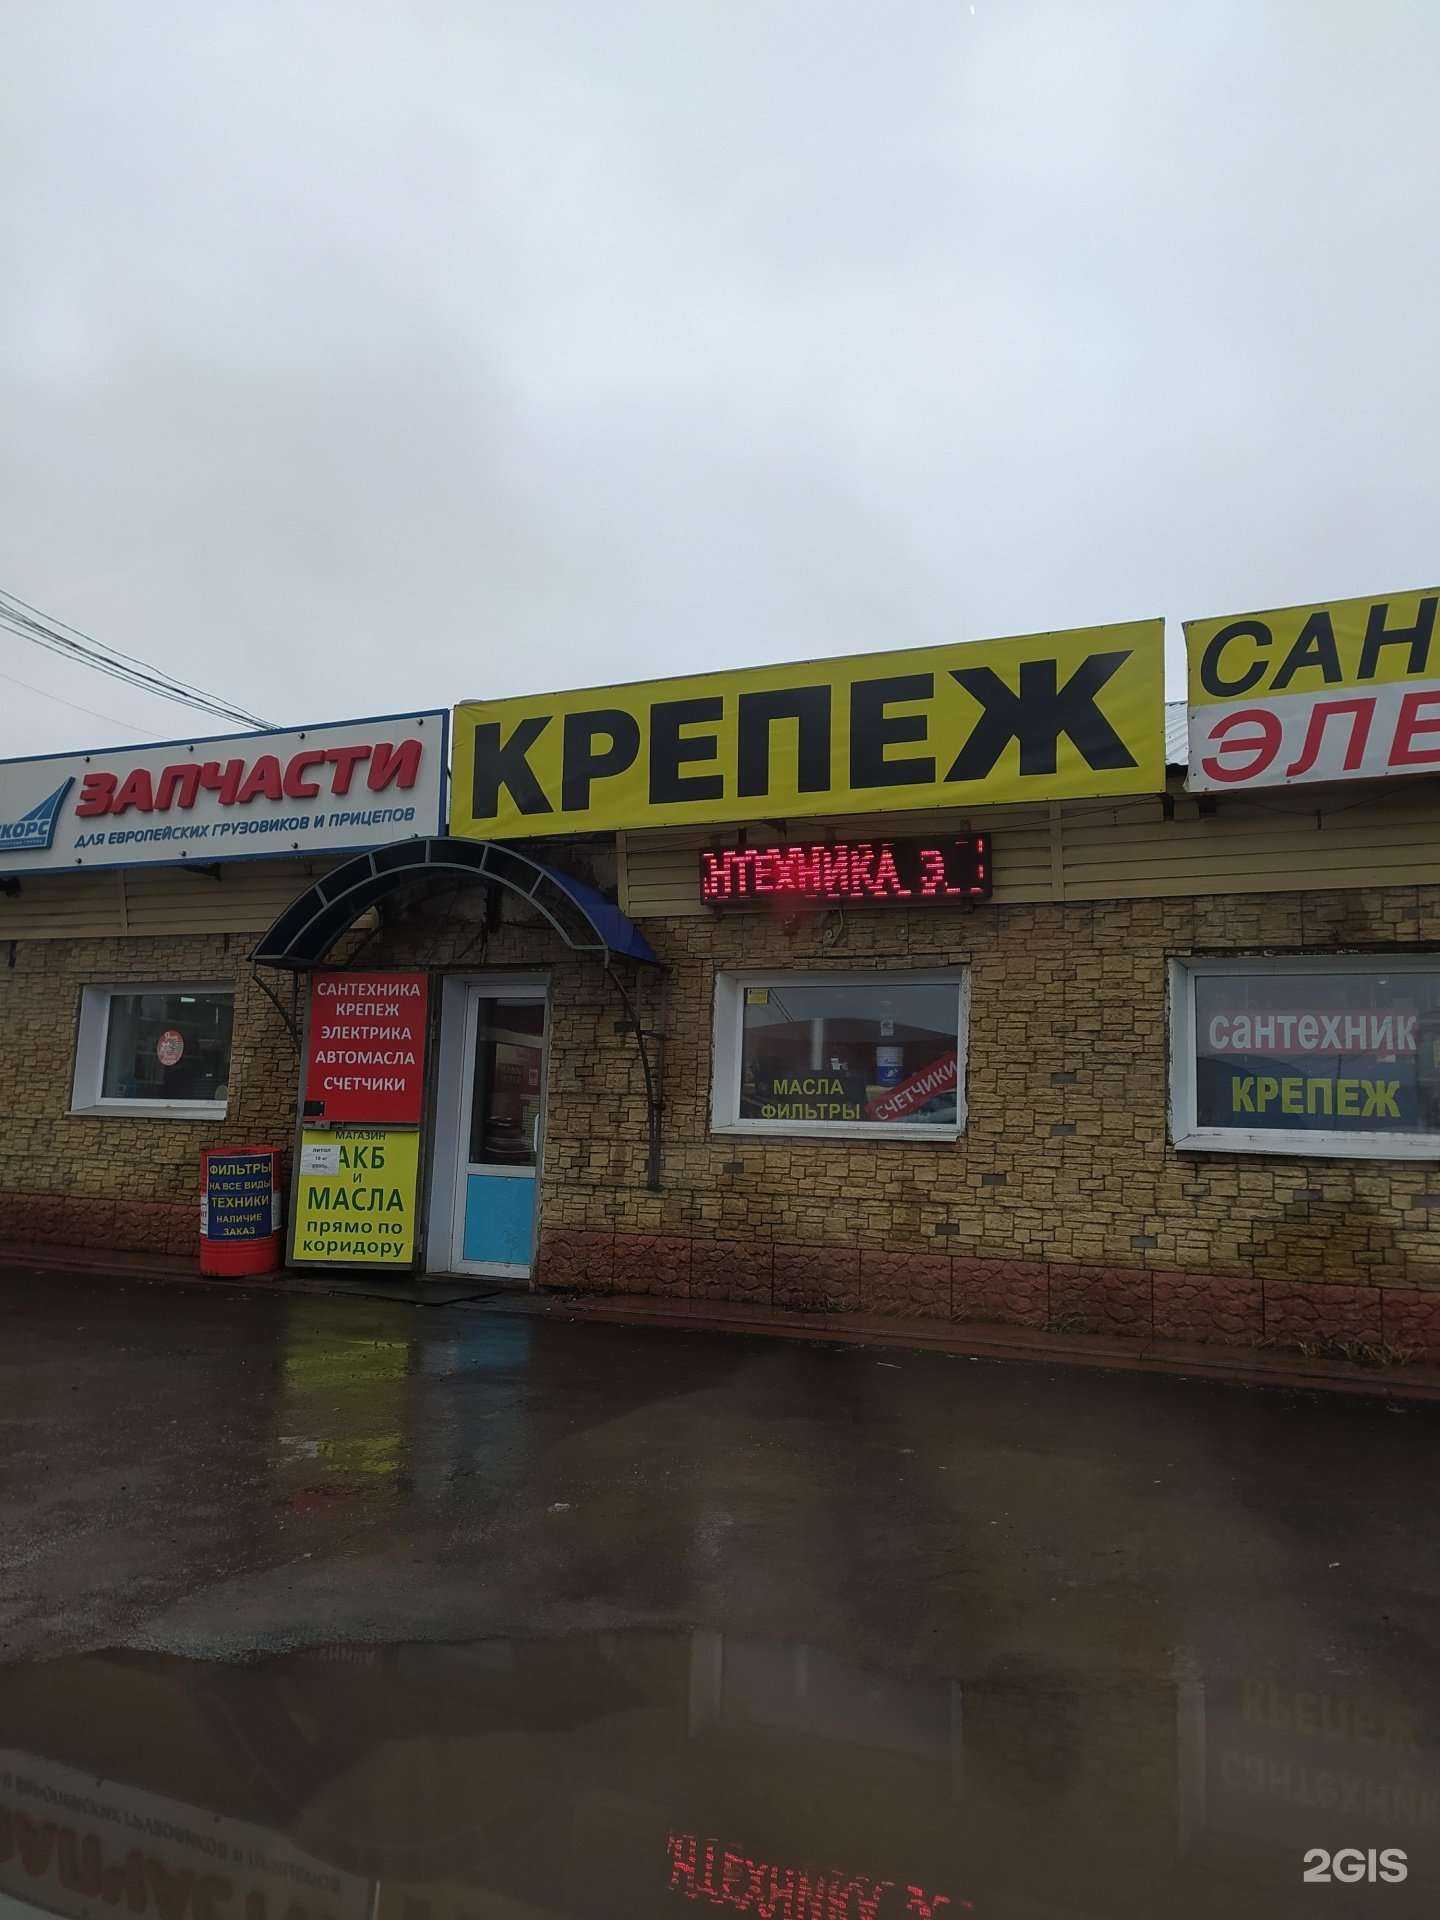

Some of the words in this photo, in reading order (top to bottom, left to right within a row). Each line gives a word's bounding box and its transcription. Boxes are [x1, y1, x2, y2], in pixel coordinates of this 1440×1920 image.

[1201, 597, 1440, 697] САН
[472, 650, 1138, 819] КРЕПЕЖ
[1202, 690, 1440, 783] ЭЛЕ
[75, 739, 423, 817] ЗАПЧАСТИ
[74, 832, 105, 849] ДЛЯ
[108, 824, 208, 845] ЕВРОПЕЙСКИХ
[211, 814, 311, 839] ГРУЗОВИКОВ
[314, 815, 325, 828] И
[328, 807, 415, 829] ПРИЦЕПОВ
[704, 850, 903, 896] НТЕХНИКА
[317, 982, 421, 997] САНТЕХНИКА
[335, 1003, 400, 1016] КРЕПЕЖ
[320, 1026, 412, 1040] ЭЛЕКТРИКА
[1209, 1015, 1417, 1050] сантехник
[315, 1051, 415, 1065] АВТОМАСЛА
[323, 1077, 406, 1092] СЧЕТЧИКИ
[773, 1079, 844, 1095] МАСЛА
[875, 1060, 957, 1121] СЧЕТЧИКИ
[1232, 1076, 1401, 1118] КРЕПЕЖ
[761, 1103, 860, 1120] ФИЛЬТРЫ
[335, 1131, 386, 1141] МАГАЗИН
[338, 1146, 385, 1169] АКБ
[209, 1163, 272, 1176] ФИЛЬТРЫ
[209, 1182, 221, 1190] НА
[223, 1182, 242, 1190] ВСЕ
[244, 1180, 271, 1190] ВИДЫ
[211, 1196, 269, 1208] ТЕХНИКИ
[307, 1187, 404, 1212] МАСЛА
[216, 1213, 262, 1223] НАЛИЧИЕ
[223, 1227, 256, 1236] ЗАКАЗ
[307, 1220, 373, 1236] прямо
[378, 1222, 402, 1234] по
[303, 1240, 404, 1257] коридору
